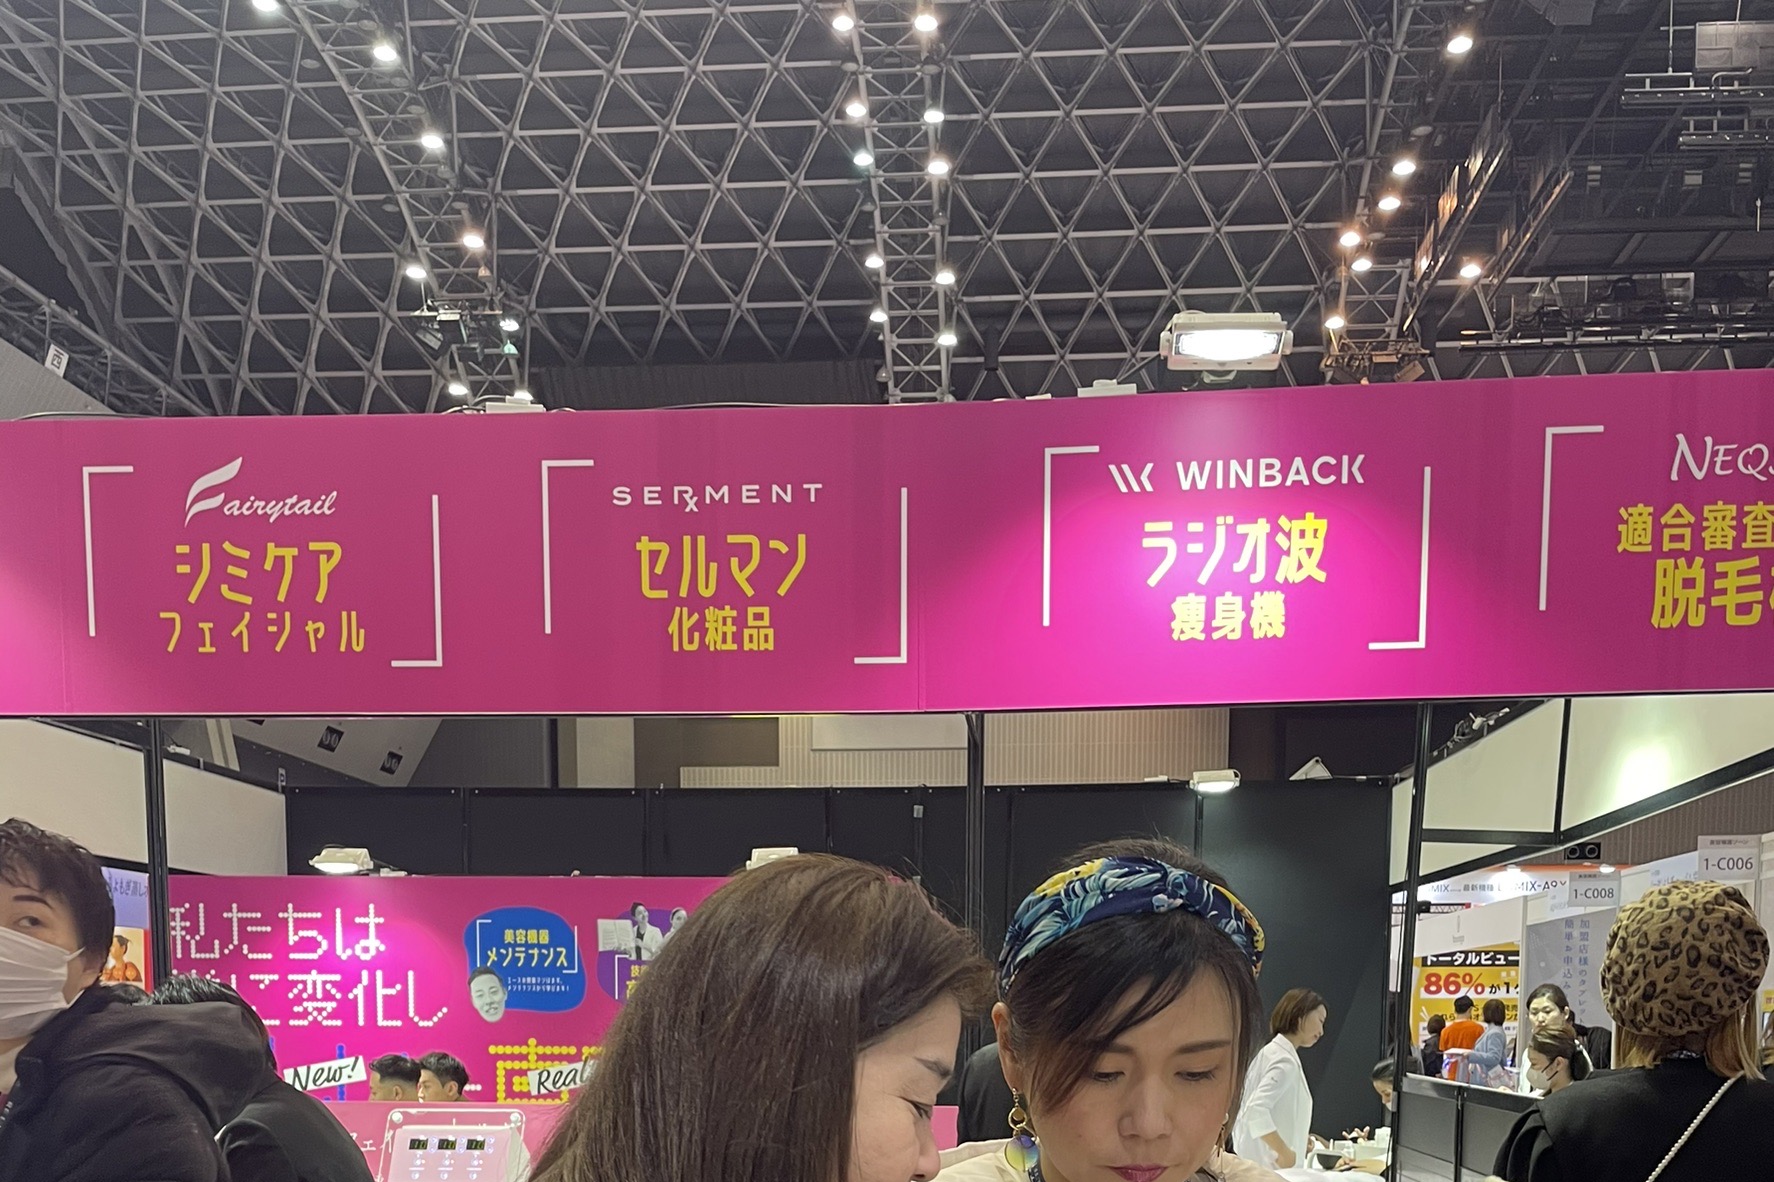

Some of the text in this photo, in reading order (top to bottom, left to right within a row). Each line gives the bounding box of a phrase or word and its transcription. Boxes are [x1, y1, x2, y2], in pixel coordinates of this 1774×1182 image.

[1176, 454, 1365, 491] WINBACK
[1670, 433, 1774, 482] NEQ
[184, 456, 338, 528] Fairytail
[1142, 512, 1328, 587] ラジオ波
[1617, 500, 1774, 553] 適合審査
[175, 541, 343, 605] シミケア
[636, 533, 806, 599] セルマン
[1651, 555, 1774, 629] 脱毛
[159, 611, 365, 653] フェイシャル
[668, 605, 774, 652] 化粧品
[1704, 857, 1753, 871] 1-C006
[1574, 888, 1614, 900] 1-C008
[169, 902, 386, 961] 私たちは
[486, 947, 568, 968] メンテナンス
[172, 970, 447, 1026] に変化し
[292, 1056, 359, 1091] New!
